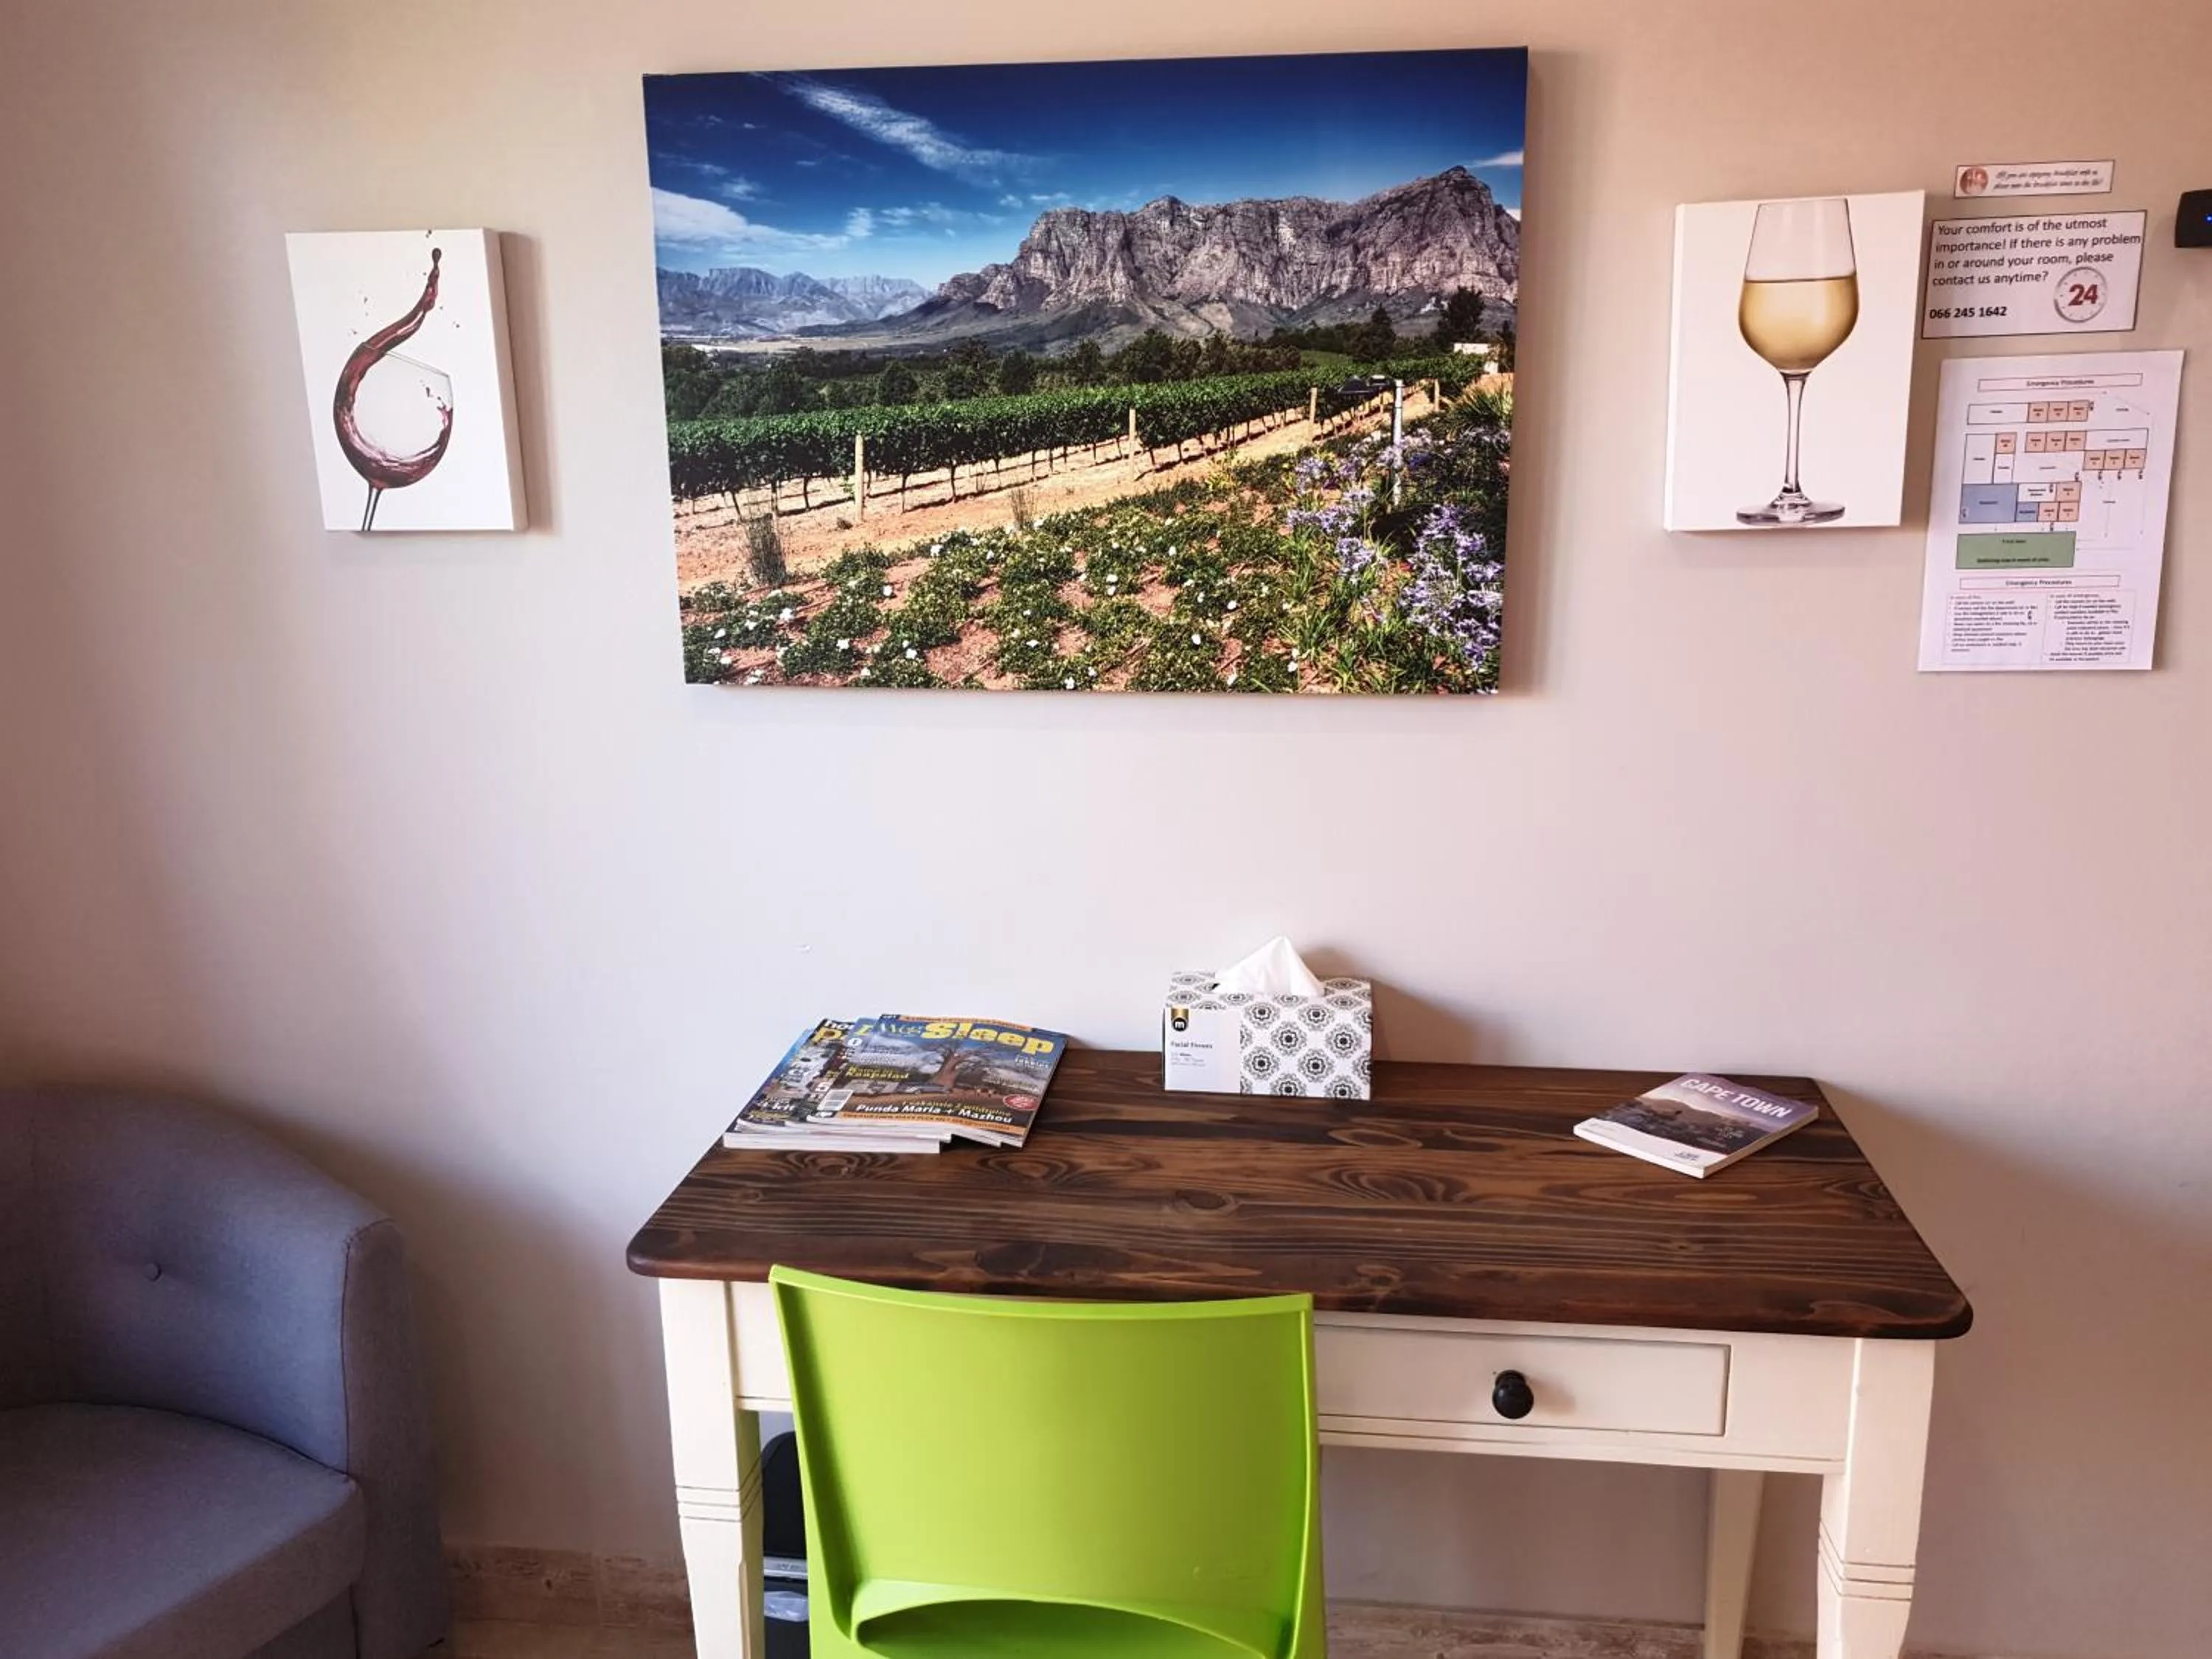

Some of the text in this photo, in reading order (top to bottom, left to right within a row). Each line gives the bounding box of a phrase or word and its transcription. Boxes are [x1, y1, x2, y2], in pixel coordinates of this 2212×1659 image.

[1938, 218, 2107, 235] Your comfort is of the utmost
[1935, 234, 2141, 254] importance! If there is any problem
[1934, 252, 2115, 269] in or around your room, please
[1933, 271, 2049, 287] contact us anytime?
[2067, 283, 2098, 307] 24
[1929, 306, 2007, 319] 066 245 1642
[920, 1023, 1054, 1056] Sleep
[1680, 1078, 1792, 1119] CAPE TOWN
[855, 1104, 899, 1113] Punda
[903, 1105, 942, 1114] Maria
[958, 1108, 1012, 1124] Mazhou
